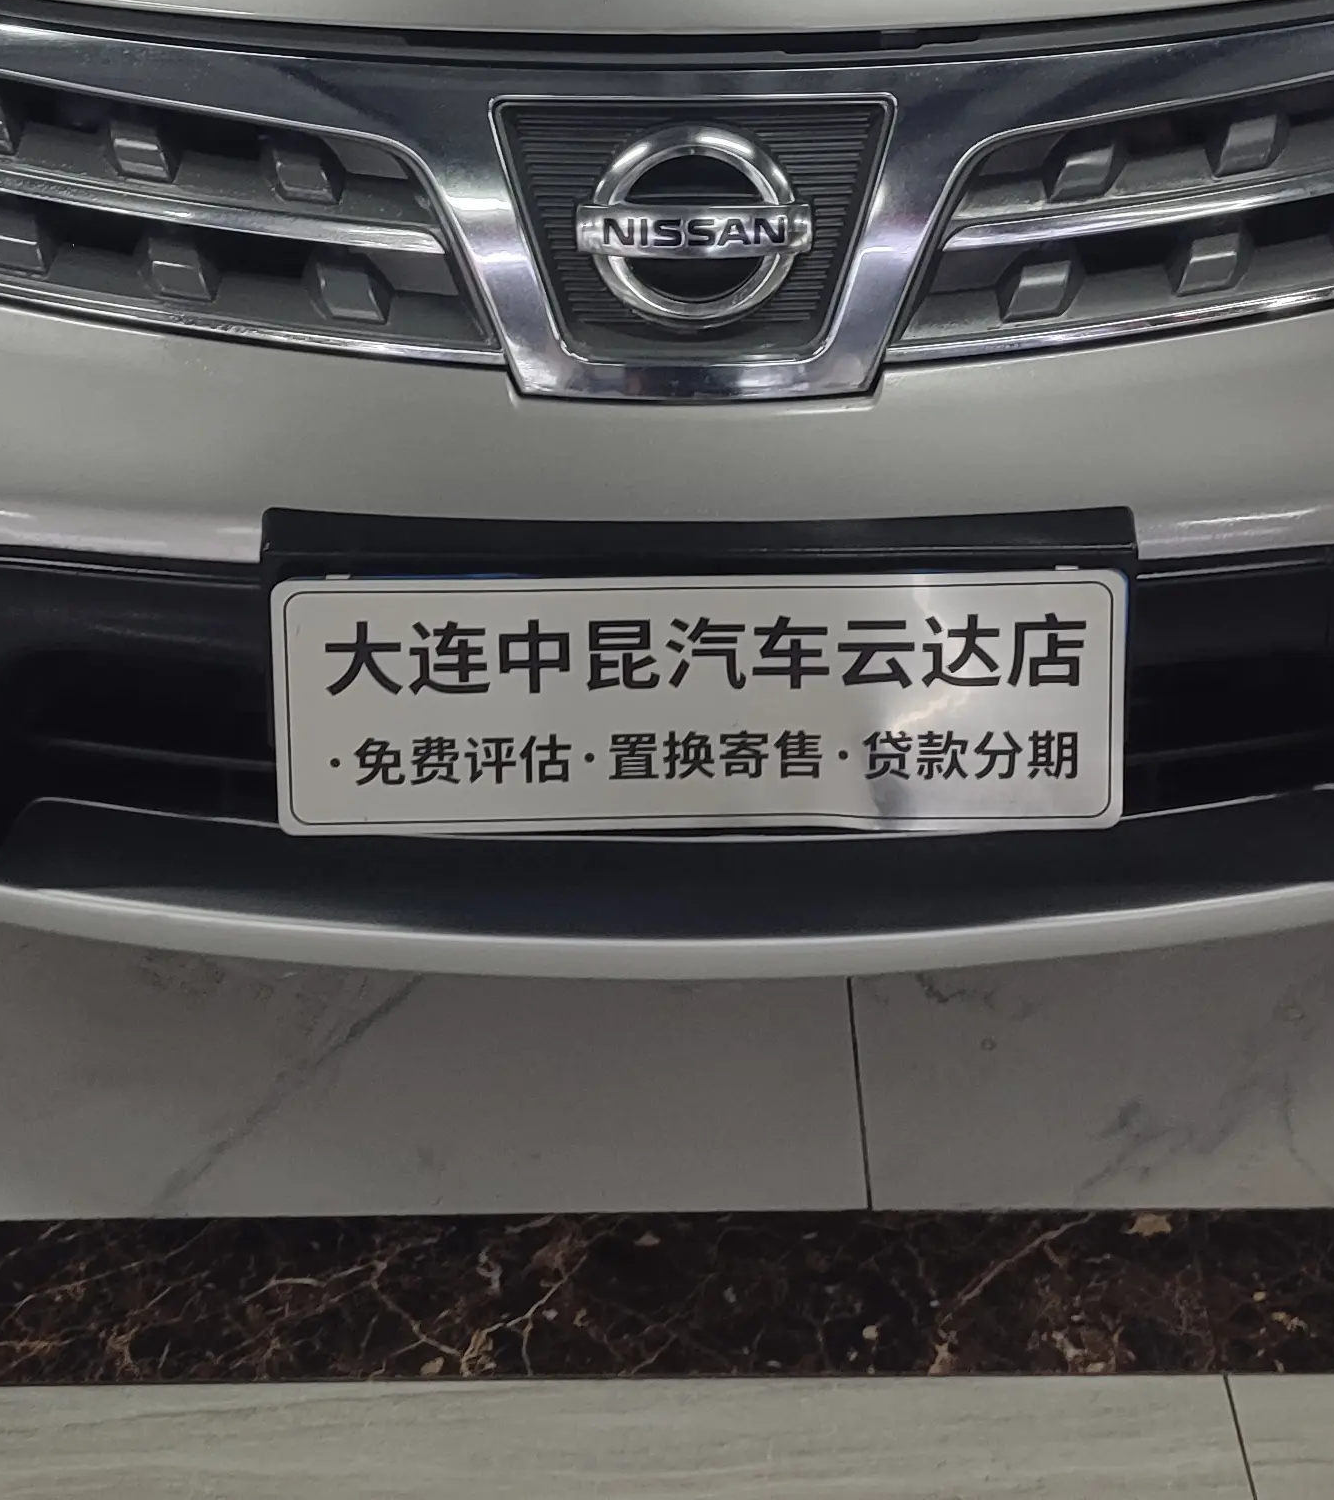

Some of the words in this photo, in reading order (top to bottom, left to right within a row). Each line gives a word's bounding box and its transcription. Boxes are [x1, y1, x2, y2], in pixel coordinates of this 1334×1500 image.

[602, 217, 786, 247] NISSAN
[325, 613, 1087, 696] 大连中昆汽车云达店
